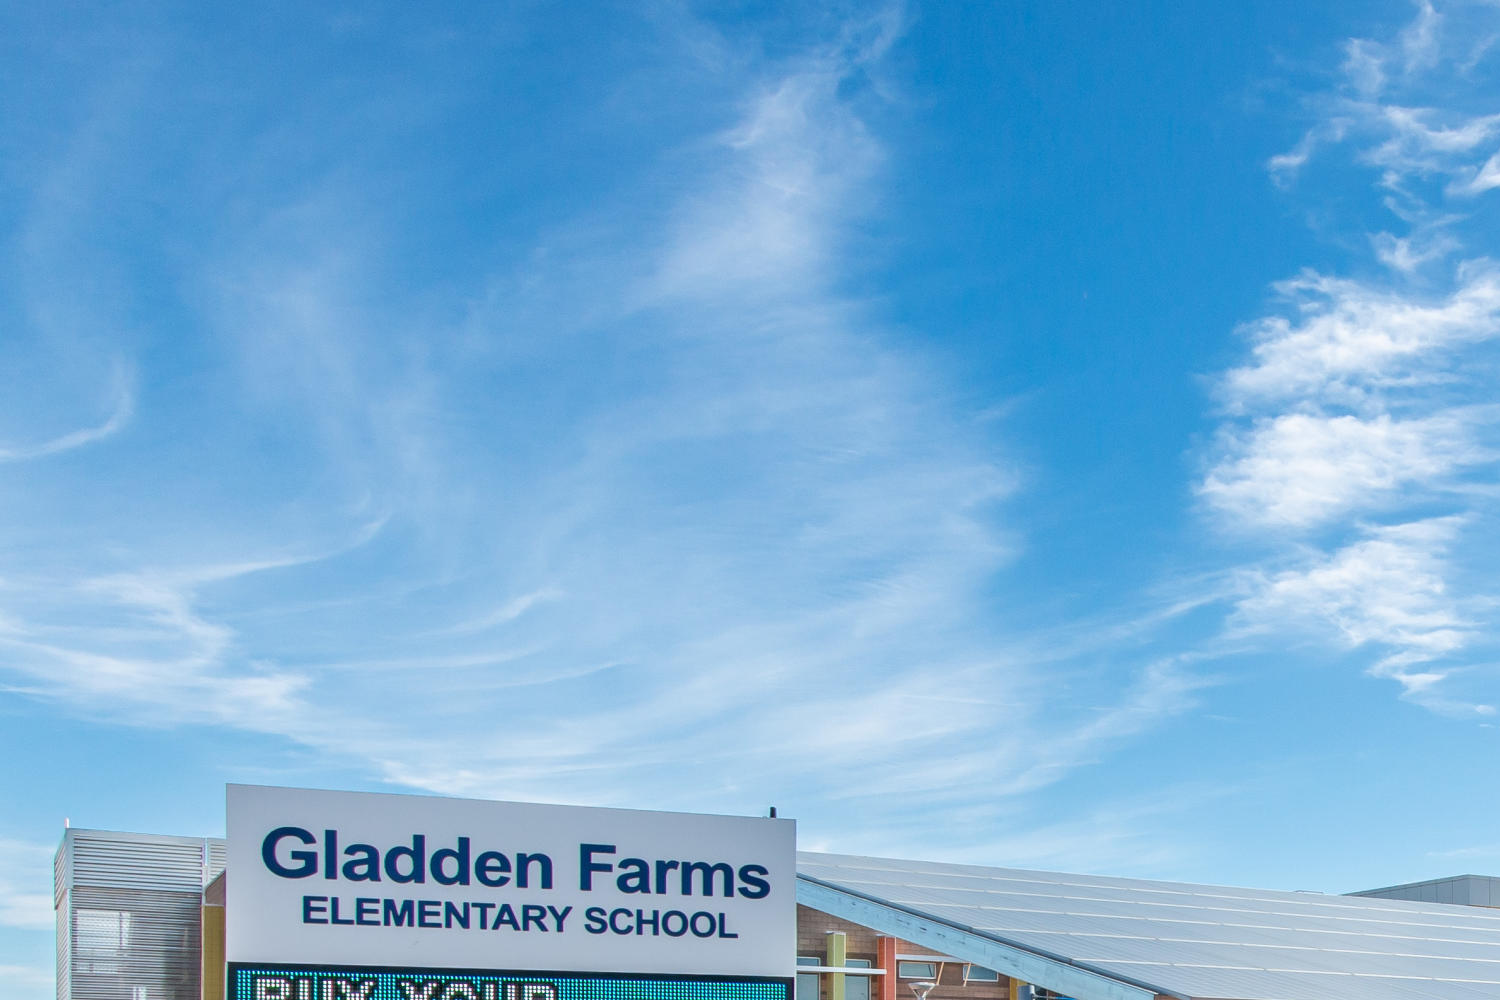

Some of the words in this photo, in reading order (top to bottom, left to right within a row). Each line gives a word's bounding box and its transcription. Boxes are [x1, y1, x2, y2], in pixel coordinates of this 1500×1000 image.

[261, 826, 553, 889] Gladden
[579, 843, 771, 900] Farms
[302, 896, 572, 933] ELEMENTARY
[584, 907, 738, 939] SCHOOL
